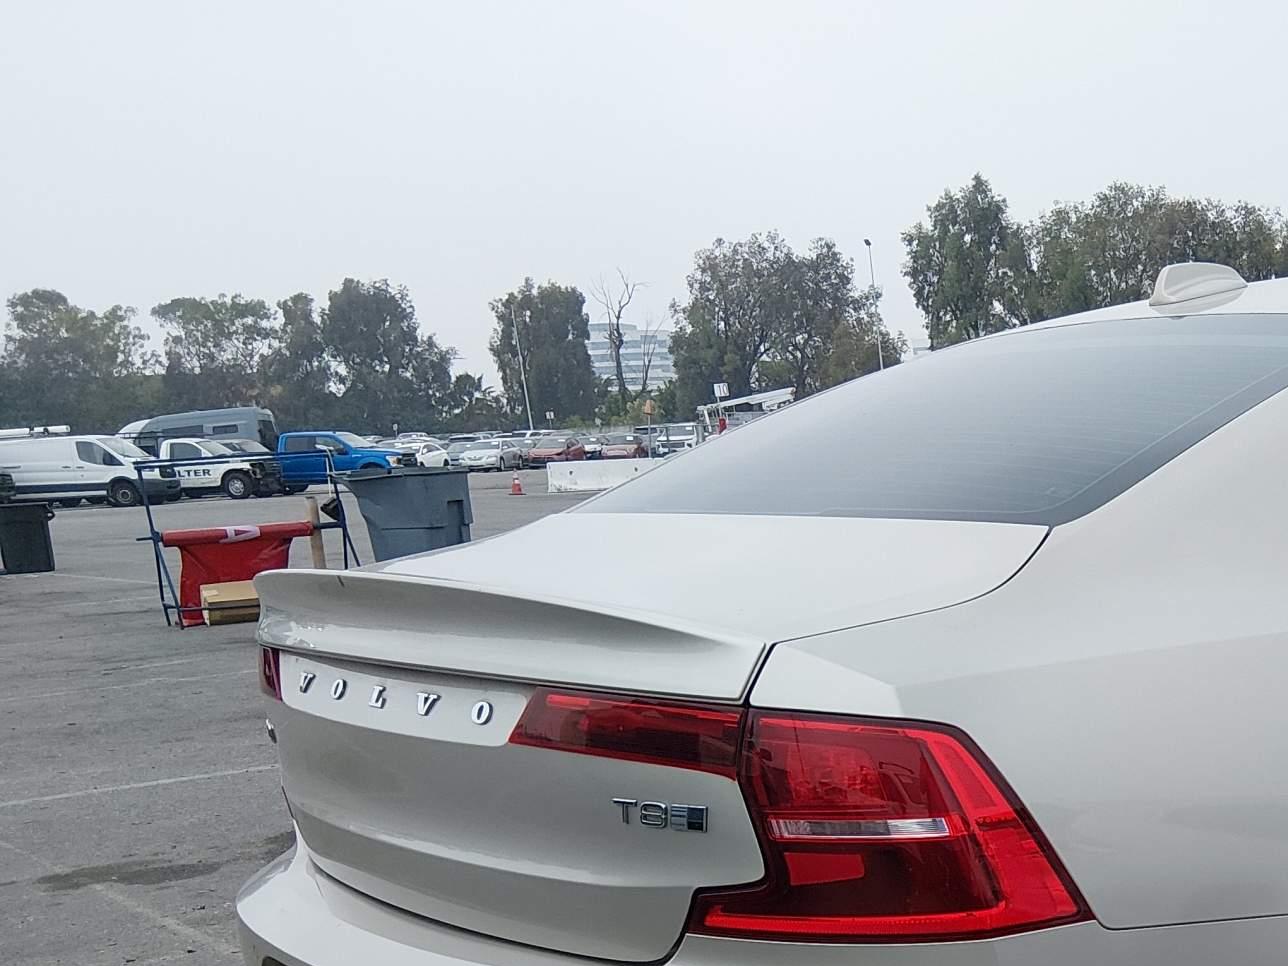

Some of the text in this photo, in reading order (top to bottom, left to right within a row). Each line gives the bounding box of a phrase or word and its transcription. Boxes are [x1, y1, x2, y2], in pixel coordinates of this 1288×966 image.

[176, 468, 211, 478] LTER
[299, 671, 494, 726] VOLVO
[611, 797, 669, 830] T8
